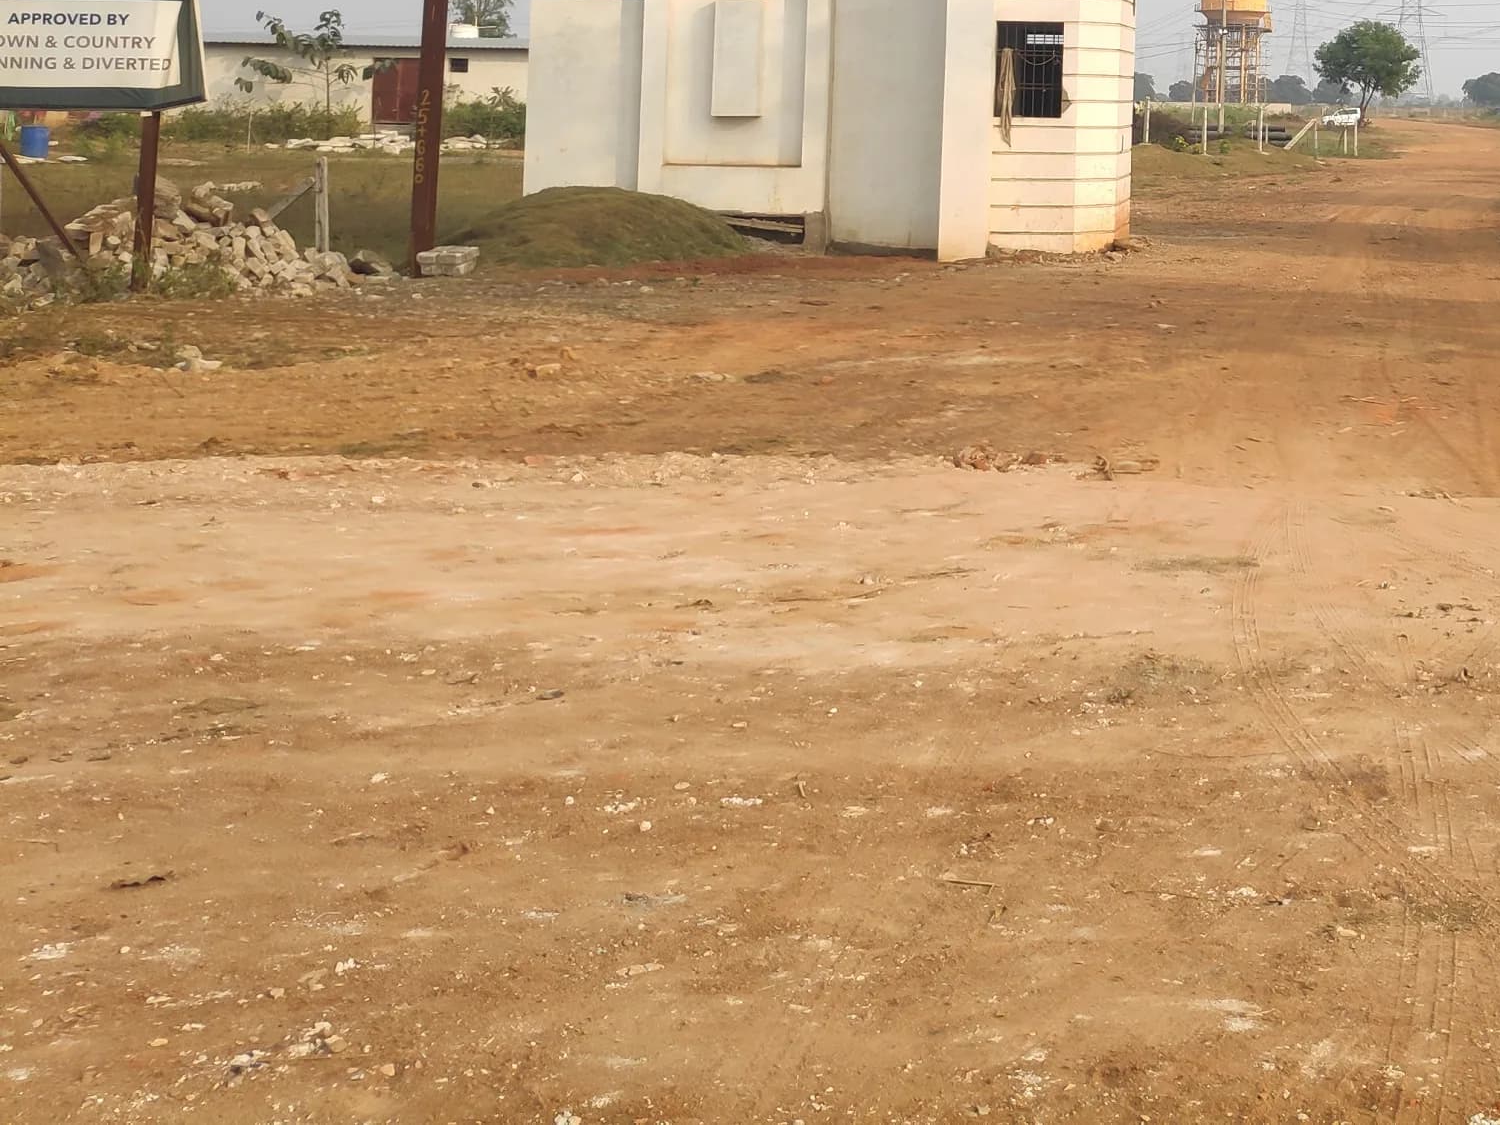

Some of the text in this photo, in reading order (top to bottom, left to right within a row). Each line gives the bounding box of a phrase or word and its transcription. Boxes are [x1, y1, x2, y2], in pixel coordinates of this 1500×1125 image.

[7, 12, 130, 26] APPROVED BY
[45, 35, 58, 48] &
[63, 35, 156, 49] COUNTRY
[63, 57, 76, 70] &
[82, 57, 172, 71] DIVERTED
